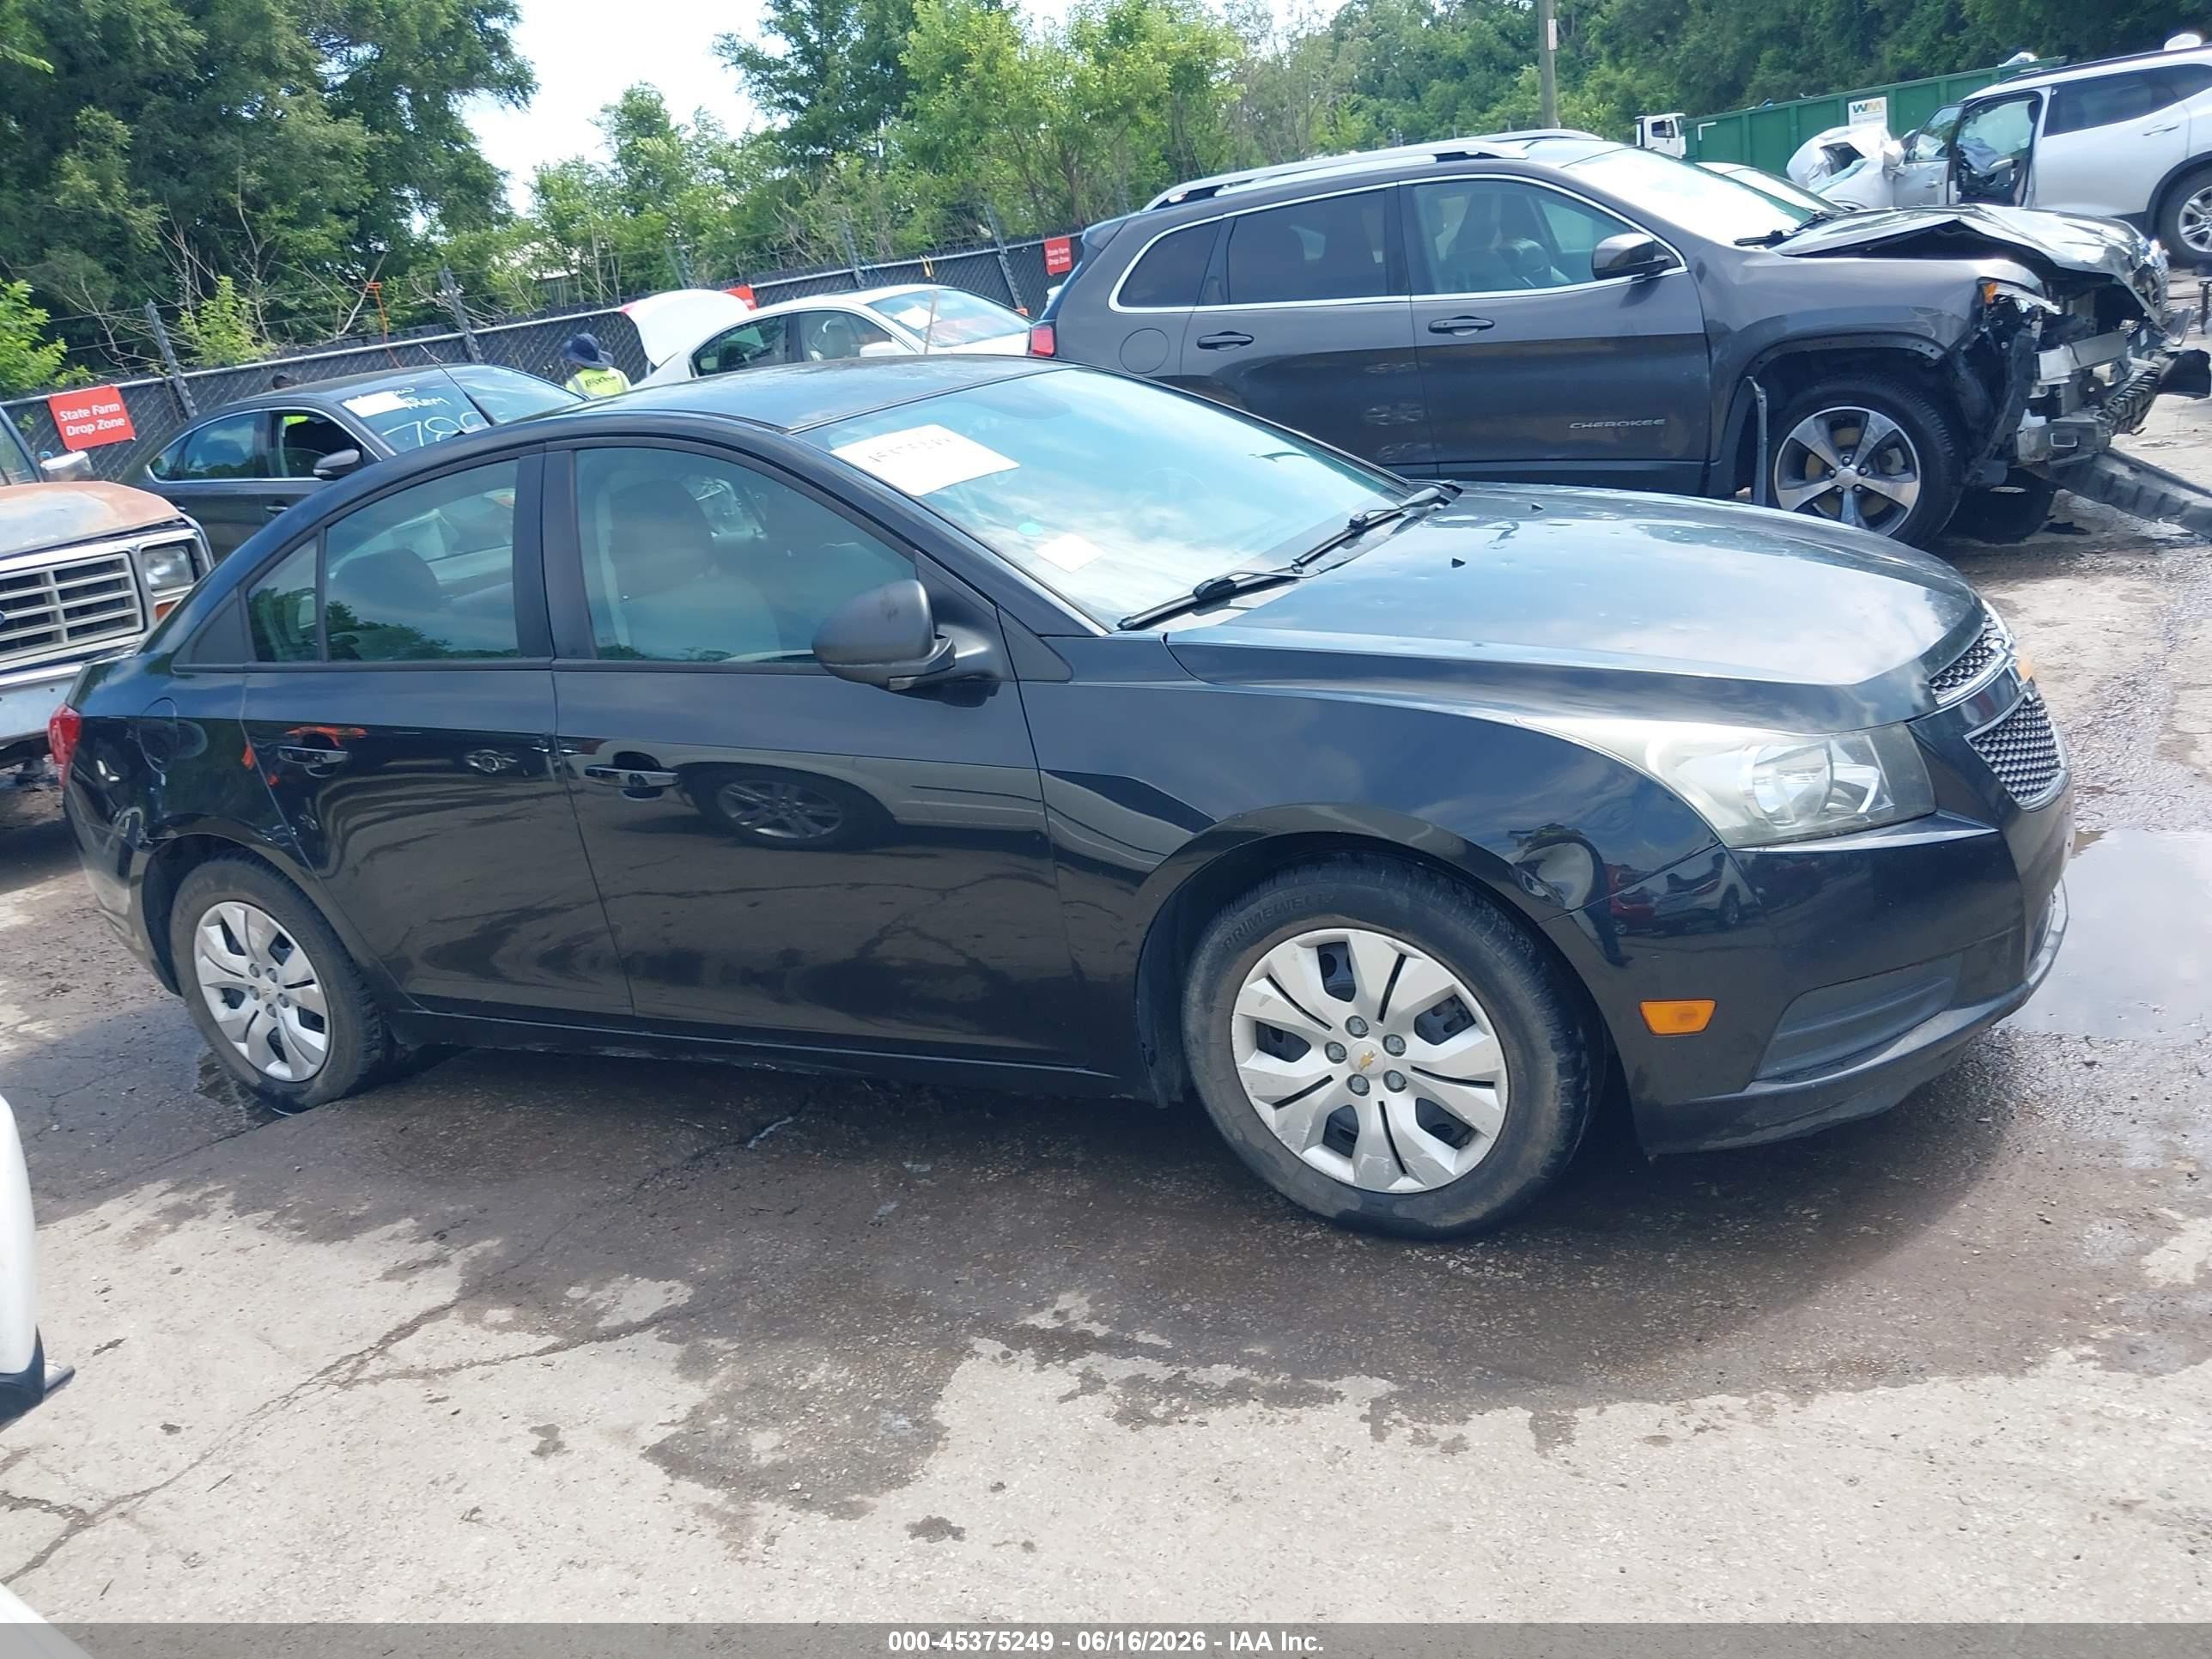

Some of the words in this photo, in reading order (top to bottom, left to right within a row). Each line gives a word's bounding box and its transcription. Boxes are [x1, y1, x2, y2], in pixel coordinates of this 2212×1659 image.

[1852, 100, 1883, 113] WM
[59, 409, 90, 422] State
[92, 403, 120, 416] Farm
[65, 423, 96, 436] Drop
[96, 417, 125, 430] Zone
[1569, 418, 1666, 428] CHEROKEE
